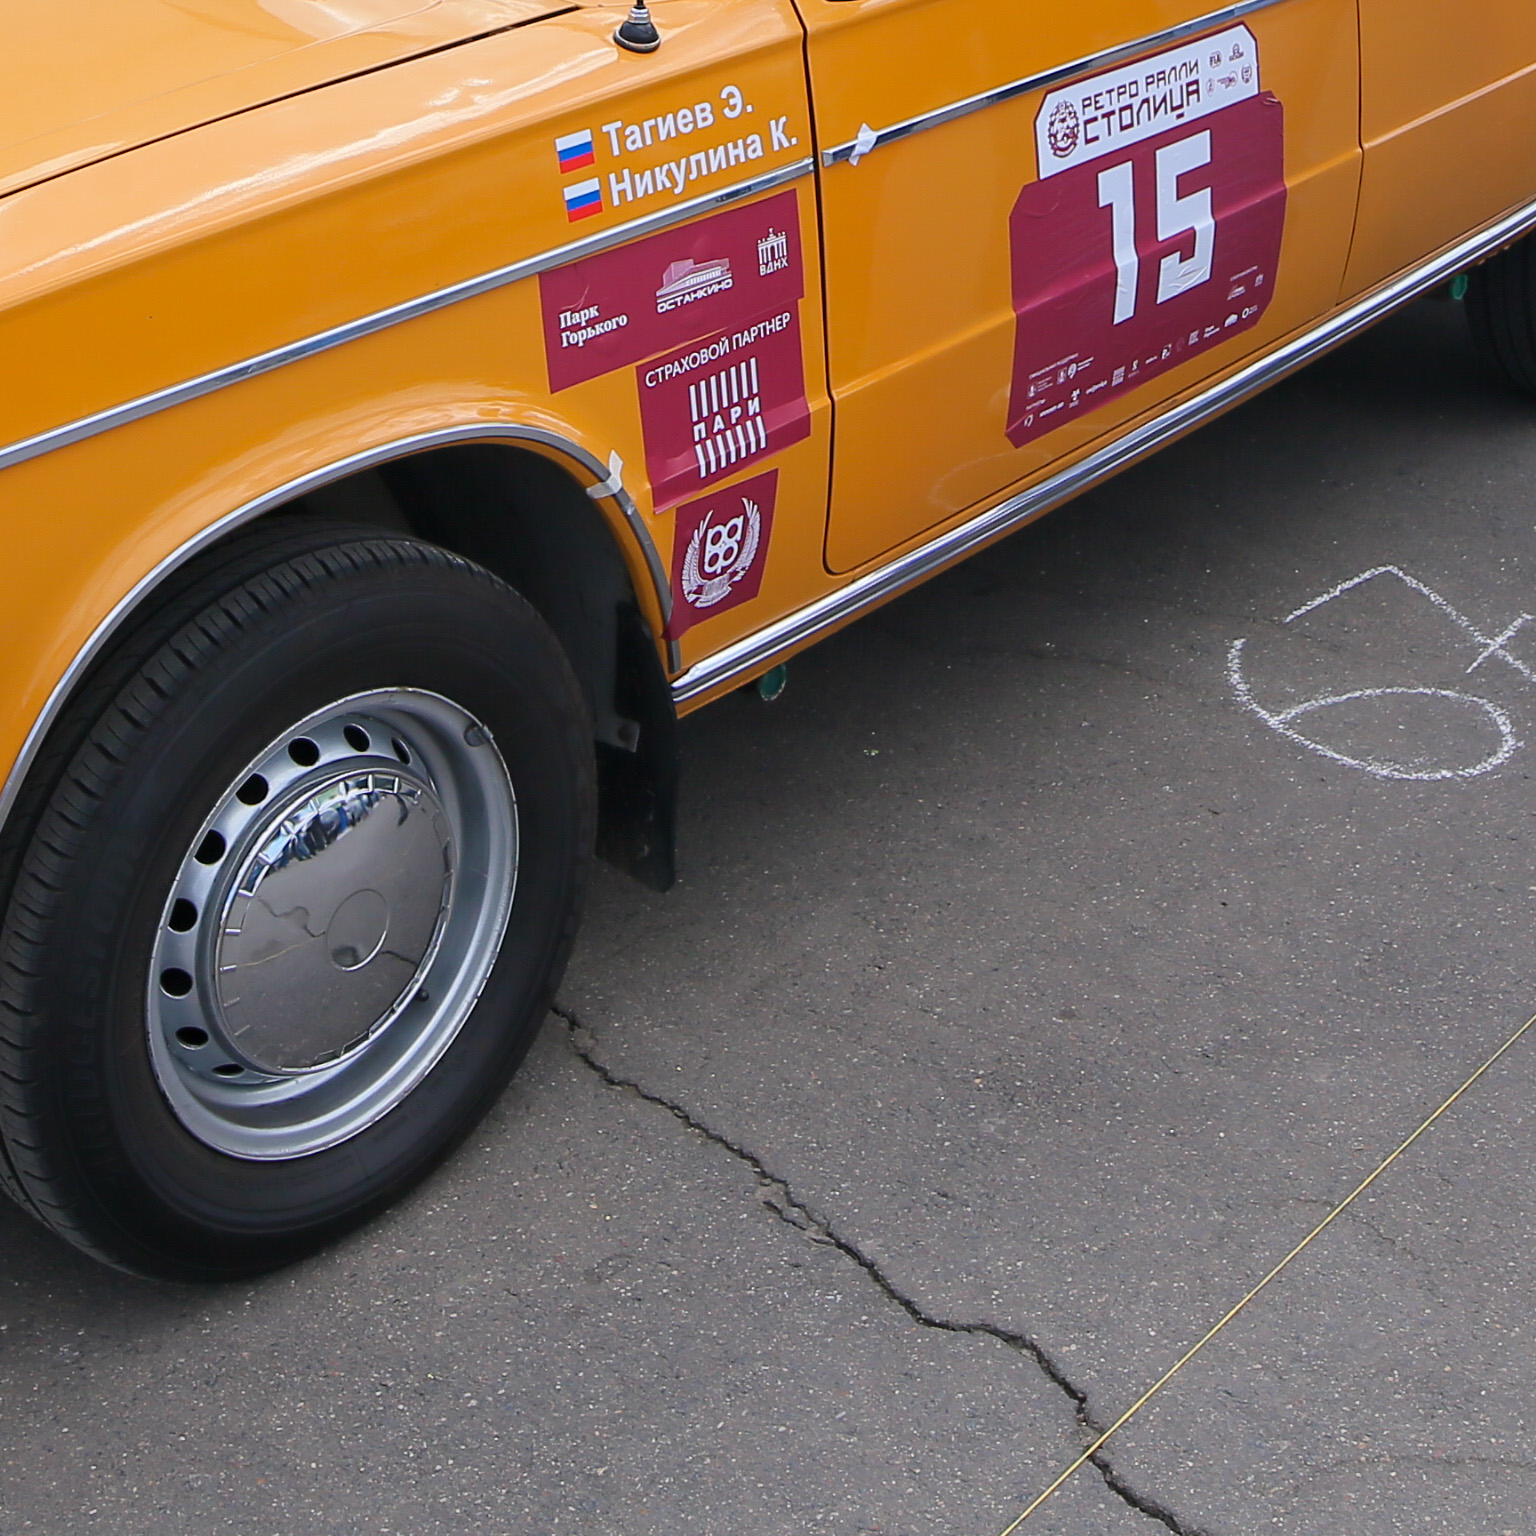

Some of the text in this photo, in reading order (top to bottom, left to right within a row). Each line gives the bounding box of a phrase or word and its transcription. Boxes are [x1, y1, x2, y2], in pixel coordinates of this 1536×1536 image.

[1081, 80, 1139, 115] РЕТРО
[1145, 59, 1200, 93] РАЛЛИ
[1083, 78, 1201, 146] СТОЛИЦА
[601, 84, 754, 156] Тагиев Э.
[608, 115, 799, 207] Никулина К.
[1096, 128, 1216, 325] 15
[758, 256, 789, 277] ВДНХ
[558, 304, 600, 329] Парк
[656, 278, 734, 314] ОСТАНКИНО
[560, 313, 629, 348] Горького
[644, 312, 792, 388] СТРАХОВОЙ ПАРТНЕР
[693, 396, 761, 442] ПАРИ
